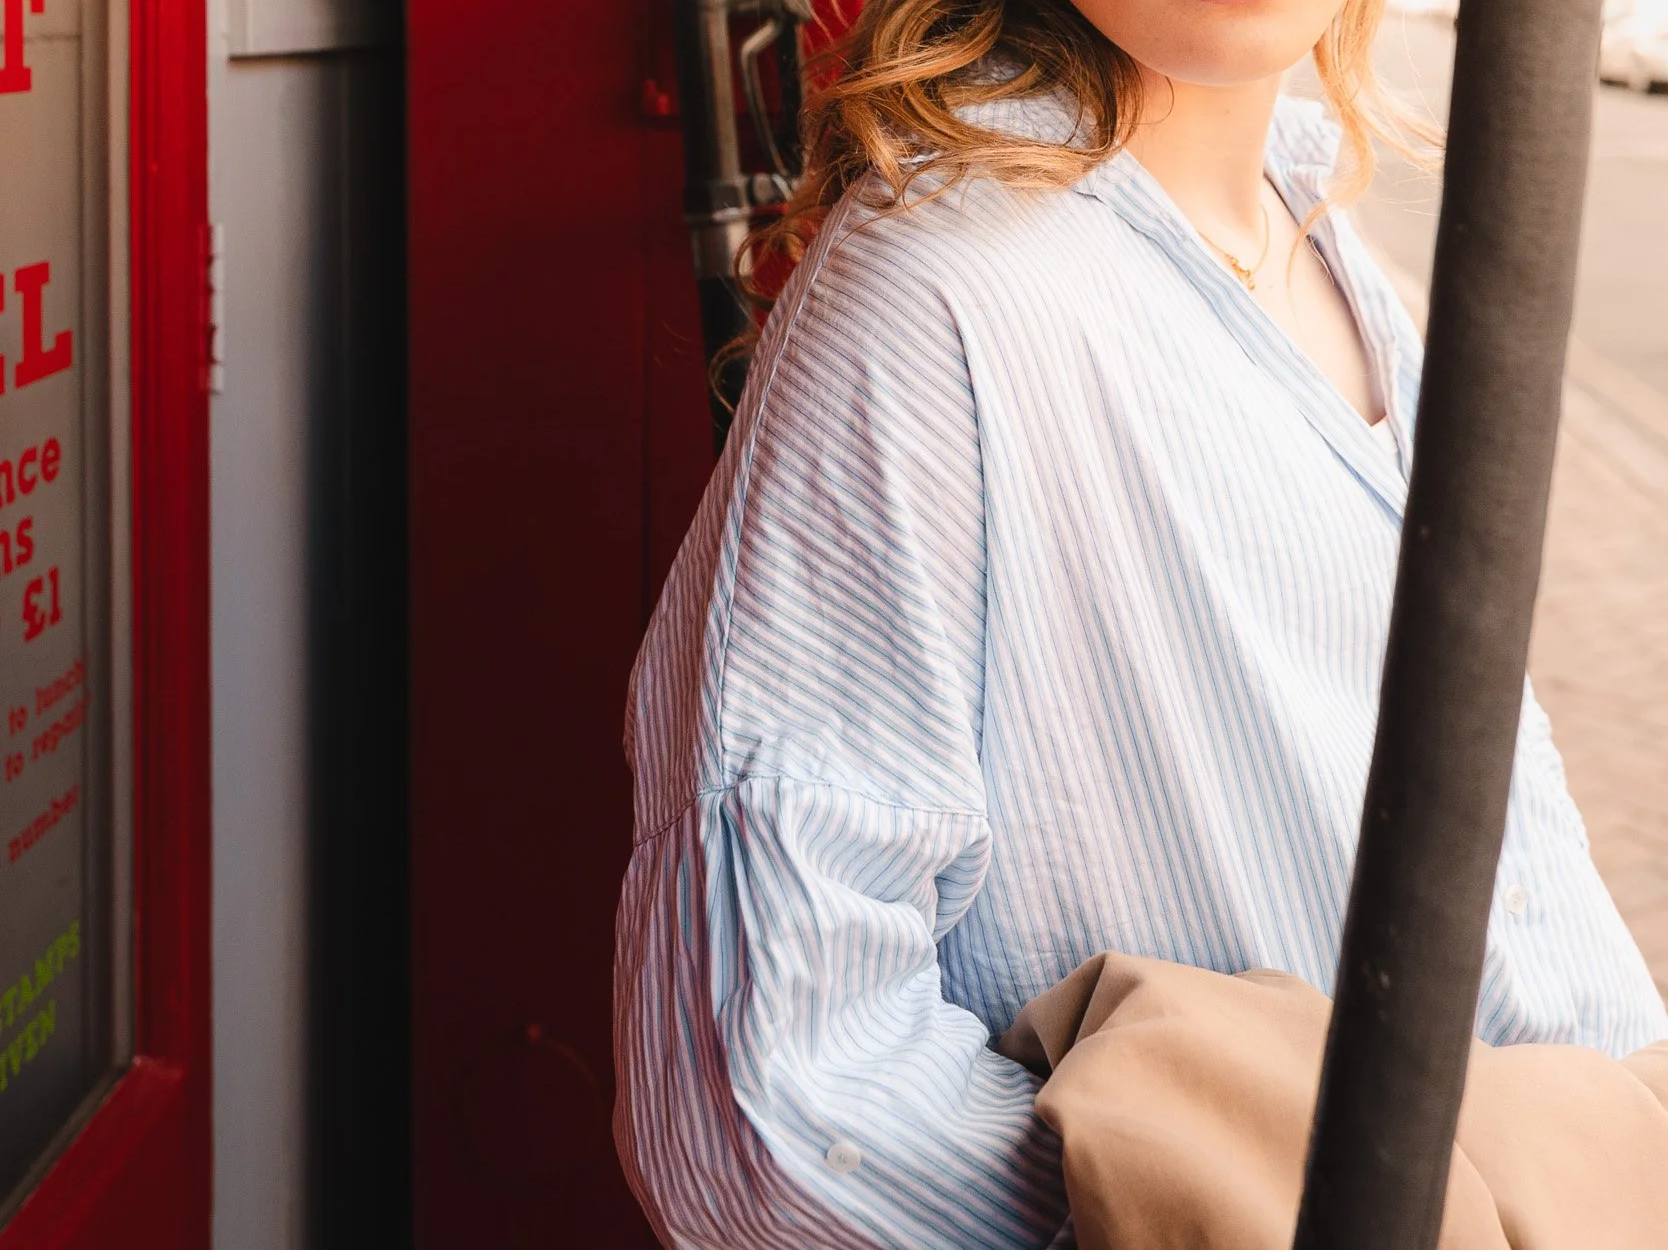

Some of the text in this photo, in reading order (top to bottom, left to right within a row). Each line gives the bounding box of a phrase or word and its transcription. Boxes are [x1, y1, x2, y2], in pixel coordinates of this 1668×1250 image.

[22, 565, 62, 643] £1
[8, 705, 28, 737] to
[5, 752, 24, 783] to
